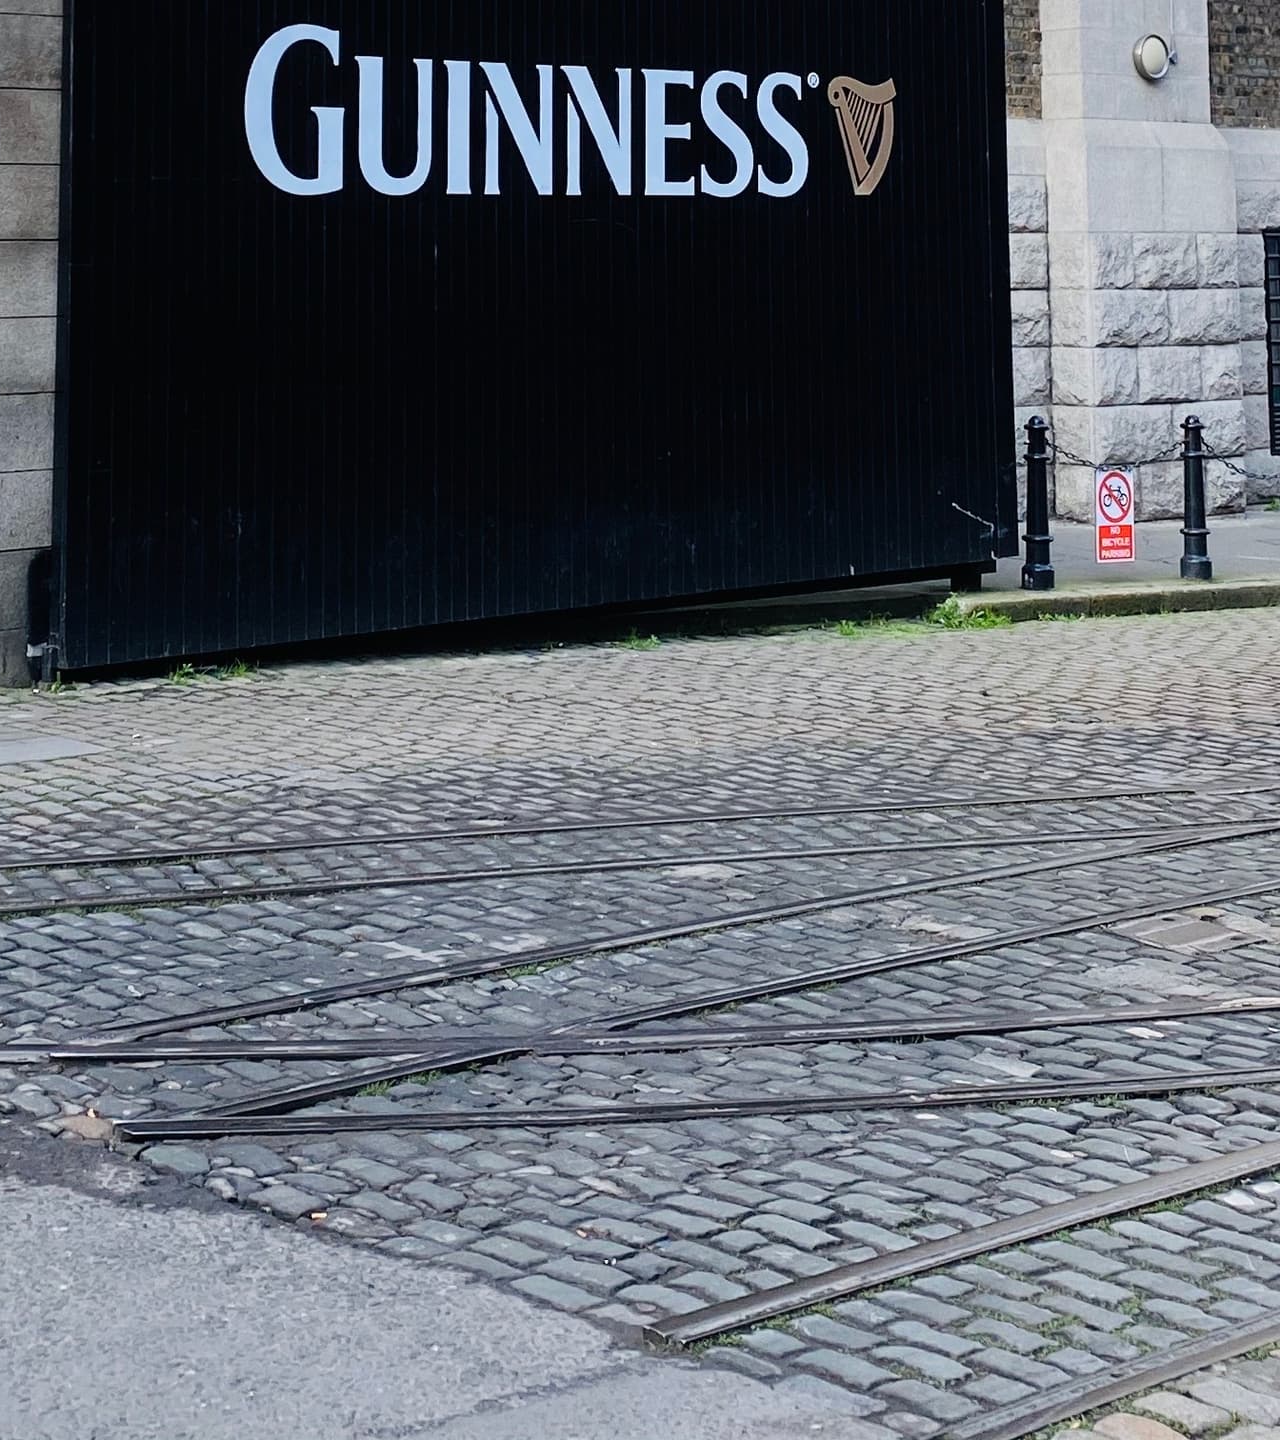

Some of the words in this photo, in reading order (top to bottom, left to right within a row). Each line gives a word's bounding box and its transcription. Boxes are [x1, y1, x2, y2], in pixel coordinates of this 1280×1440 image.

[244, 23, 809, 198] GUINNESS
[1110, 526, 1121, 535] NO
[1101, 537, 1130, 547] BICYCLE
